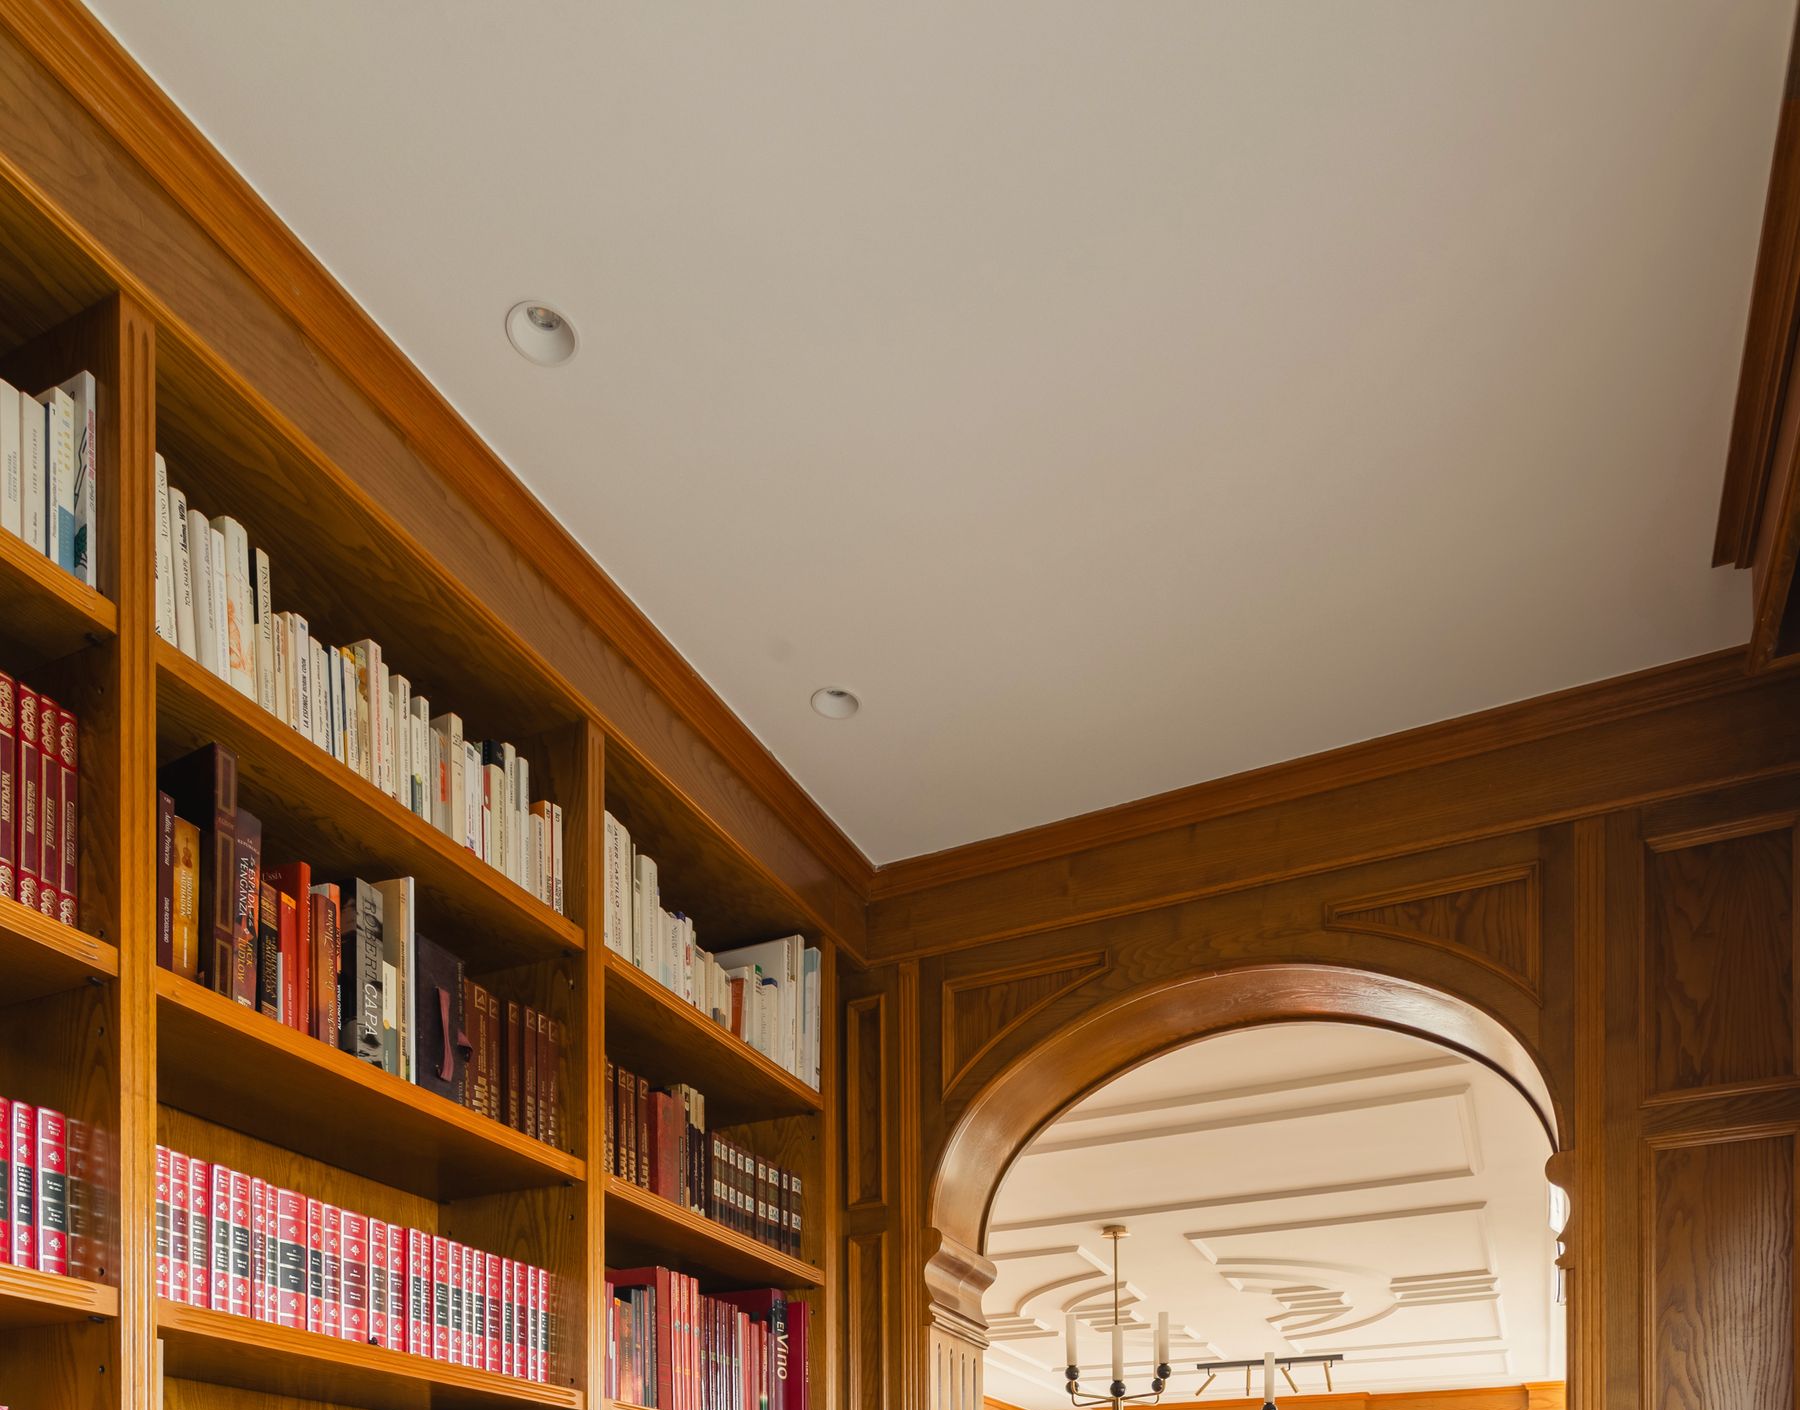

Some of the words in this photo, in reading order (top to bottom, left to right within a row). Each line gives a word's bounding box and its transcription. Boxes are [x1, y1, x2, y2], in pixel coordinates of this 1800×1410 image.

[238, 853, 249, 919] VENGANZA
[247, 867, 255, 911] ESPADA
[237, 935, 245, 984] LUDLOW
[363, 896, 377, 984] ROBERT
[363, 980, 377, 1041] CAPA
[776, 1320, 785, 1333] El
[776, 1330, 789, 1382] Vino
